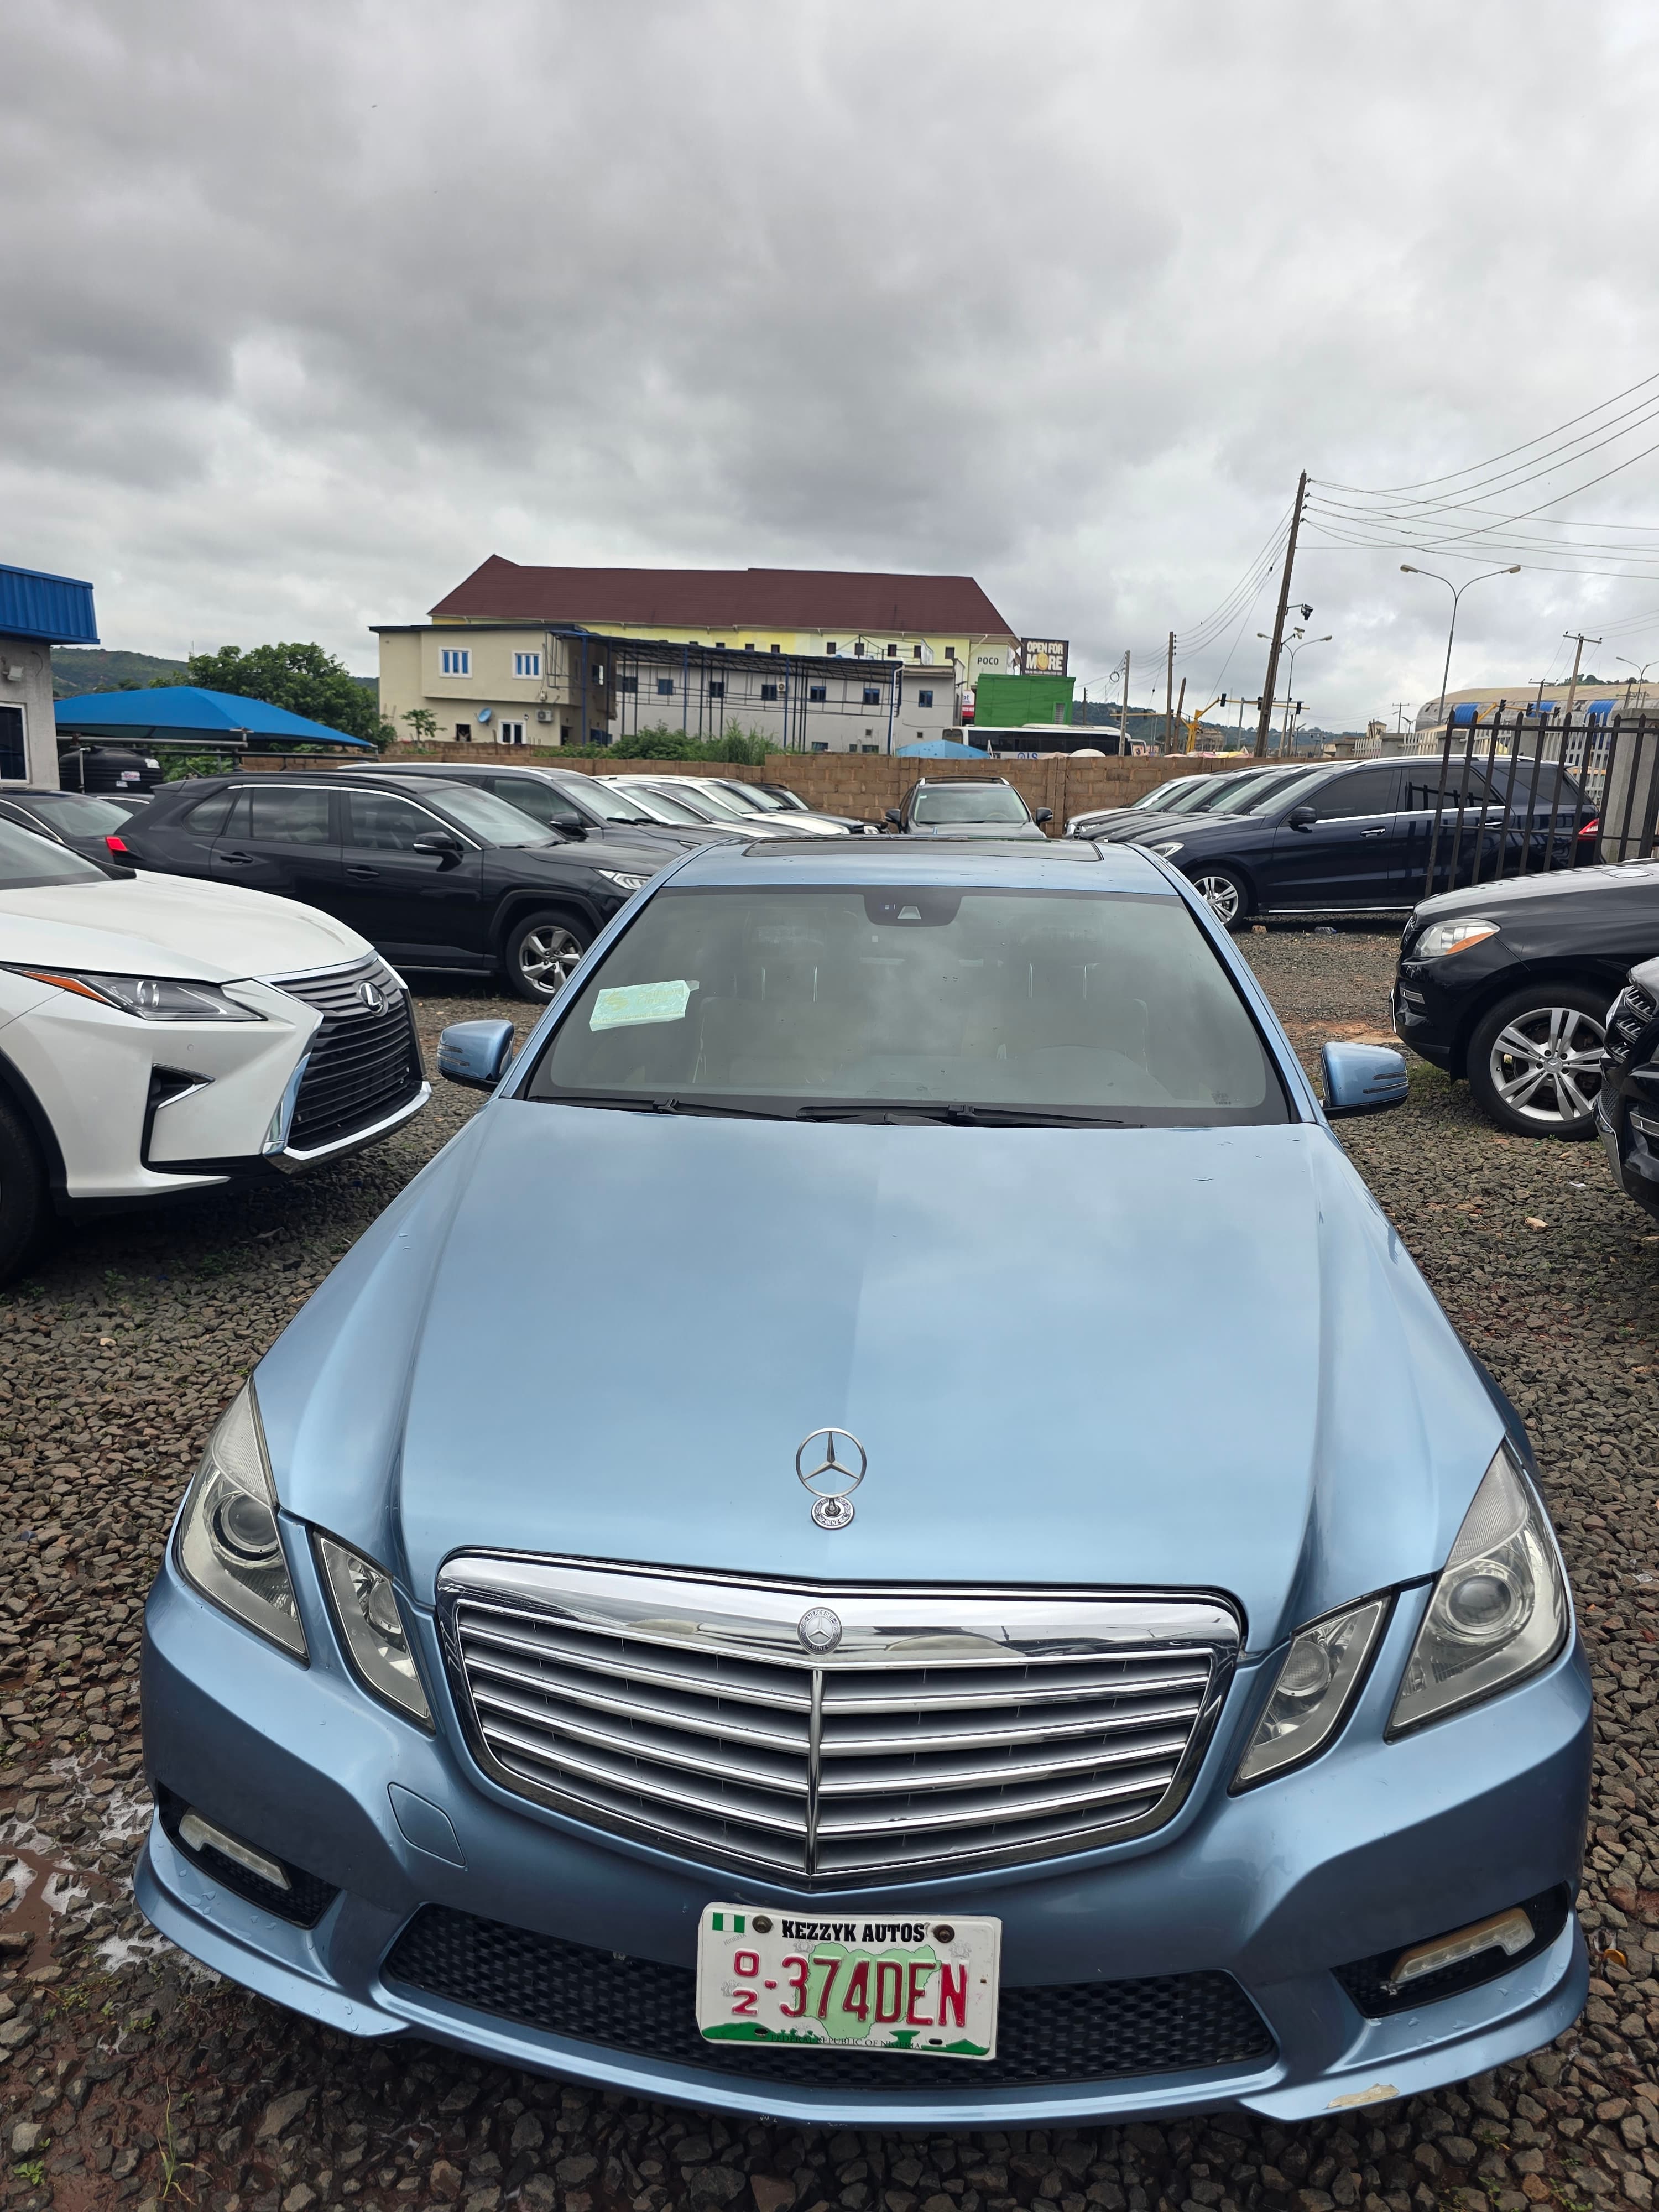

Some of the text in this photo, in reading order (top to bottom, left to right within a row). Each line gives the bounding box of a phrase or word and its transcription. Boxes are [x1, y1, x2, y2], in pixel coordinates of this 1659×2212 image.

[1027, 641, 1063, 654] OPEN FOR
[977, 656, 999, 665] POCO
[1026, 654, 1063, 671] MORE
[808, 1610, 834, 1620] MERCEDES
[782, 1919, 925, 1942] KEZZYK AUTOS
[817, 2037, 863, 2046] REPUBLIC
[881, 2041, 922, 2049] NIGERIA
